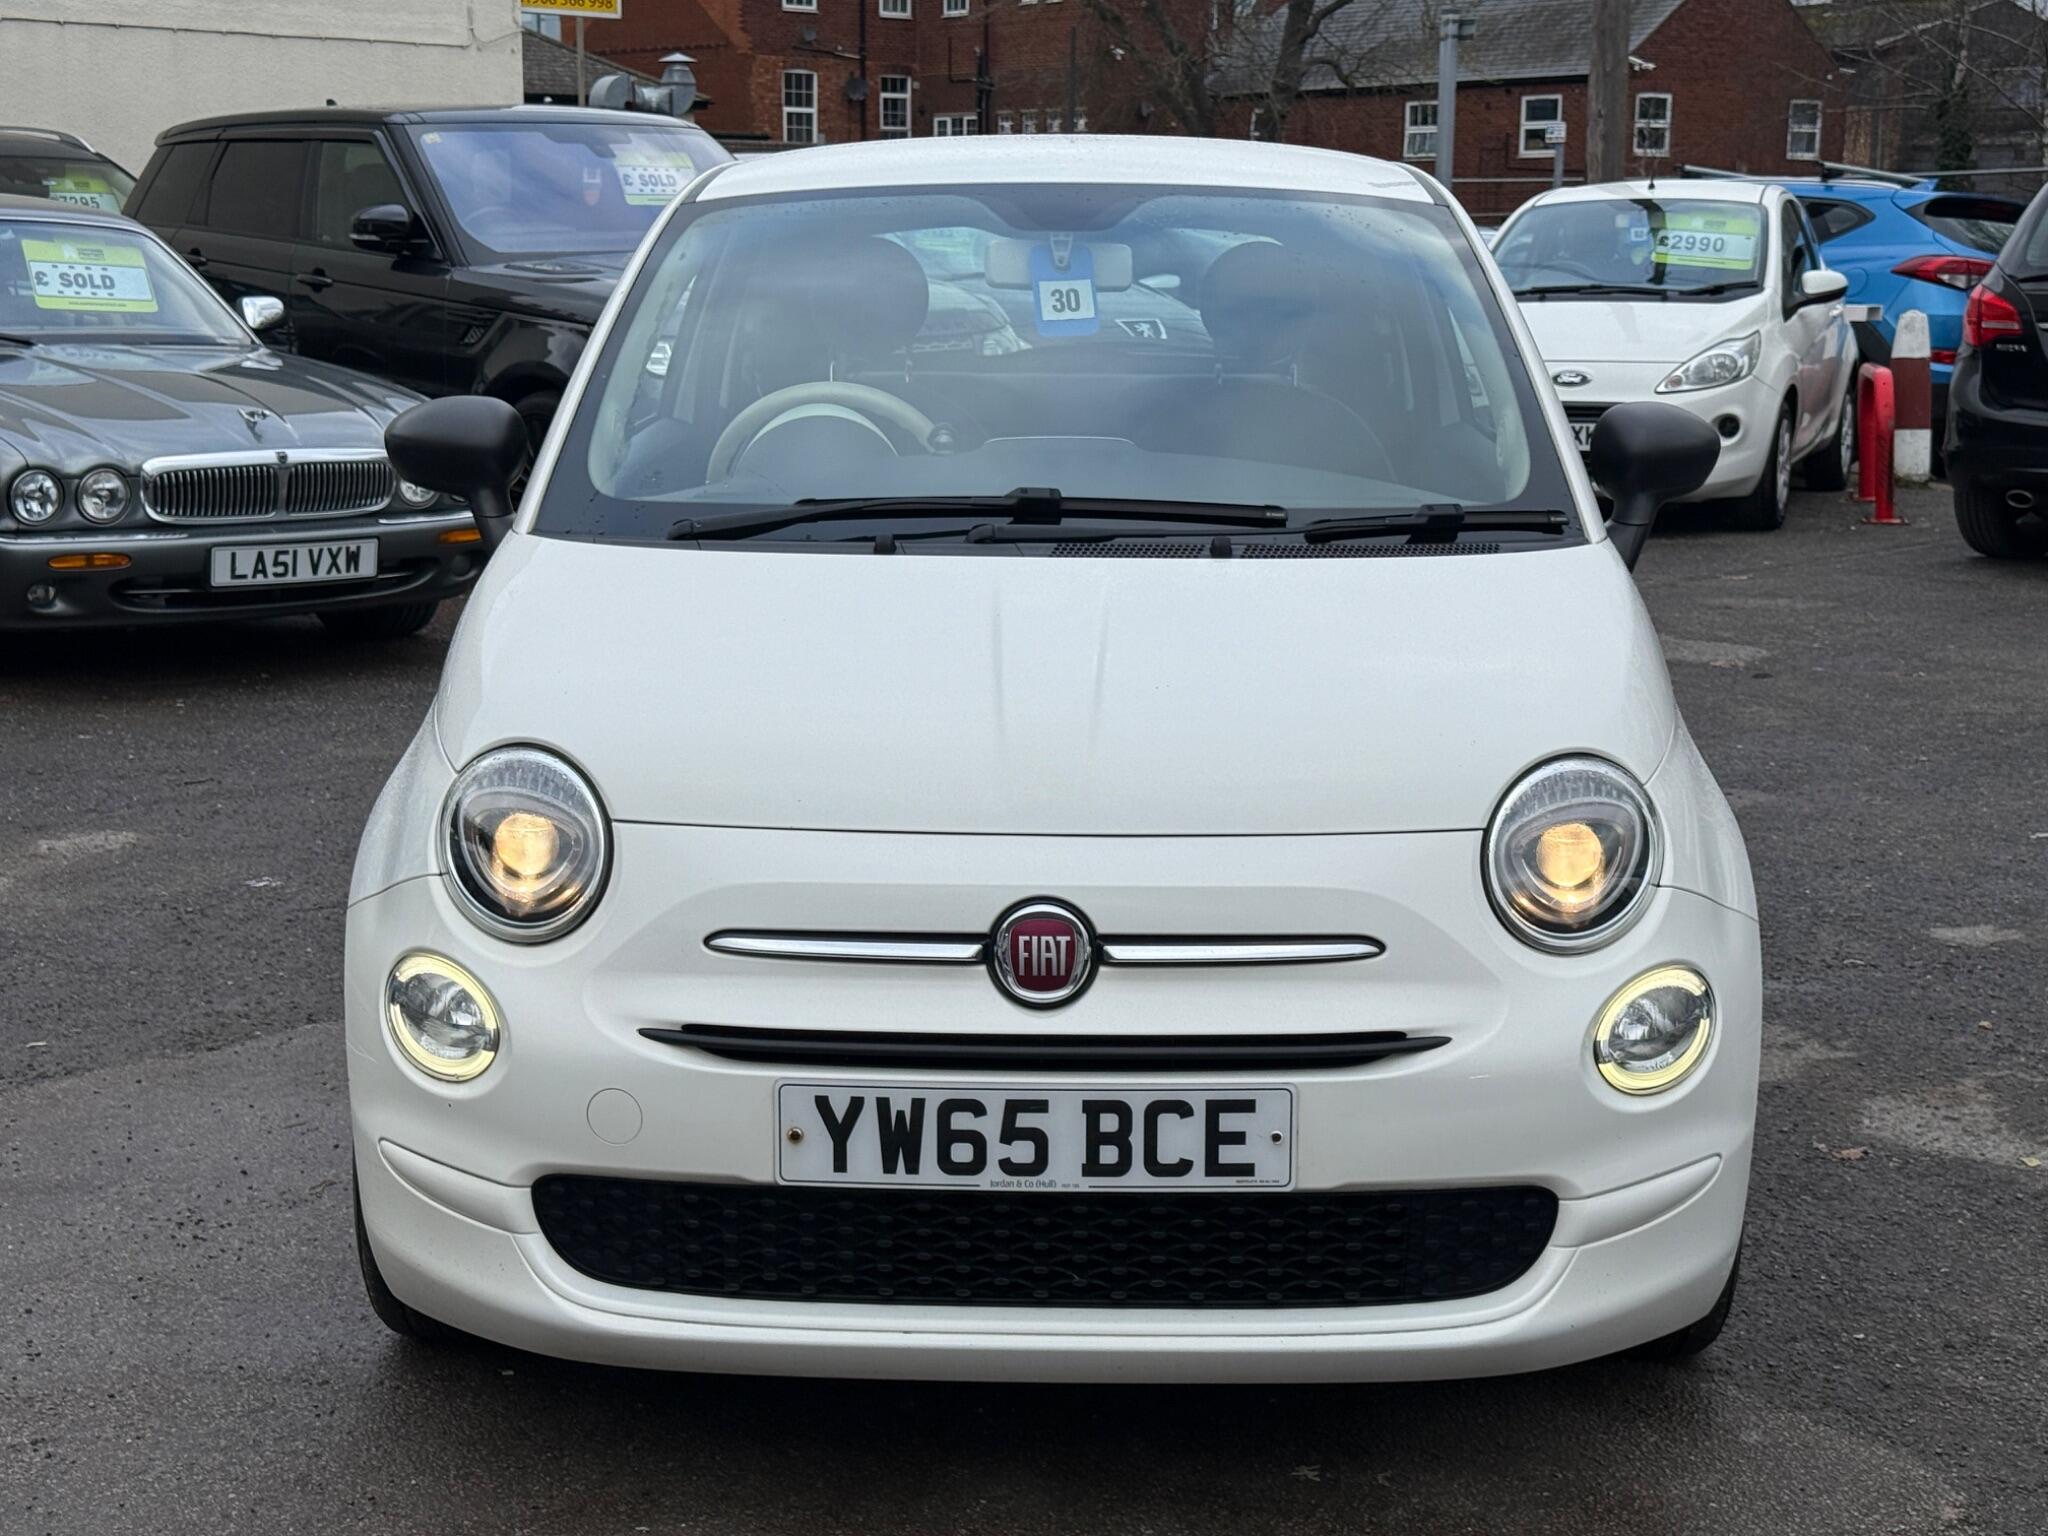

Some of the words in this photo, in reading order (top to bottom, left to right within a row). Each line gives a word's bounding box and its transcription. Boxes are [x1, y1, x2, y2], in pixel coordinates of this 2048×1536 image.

[638, 174, 677, 188] SOLD
[59, 272, 115, 290] SOLD
[1050, 288, 1080, 312] 30
[230, 548, 298, 580] LA51
[308, 545, 361, 576] VXW
[1018, 935, 1071, 977] FIAT
[813, 1094, 1050, 1177] YW65
[1081, 1099, 1257, 1178] BCE
[1024, 1179, 1034, 1188] Co
